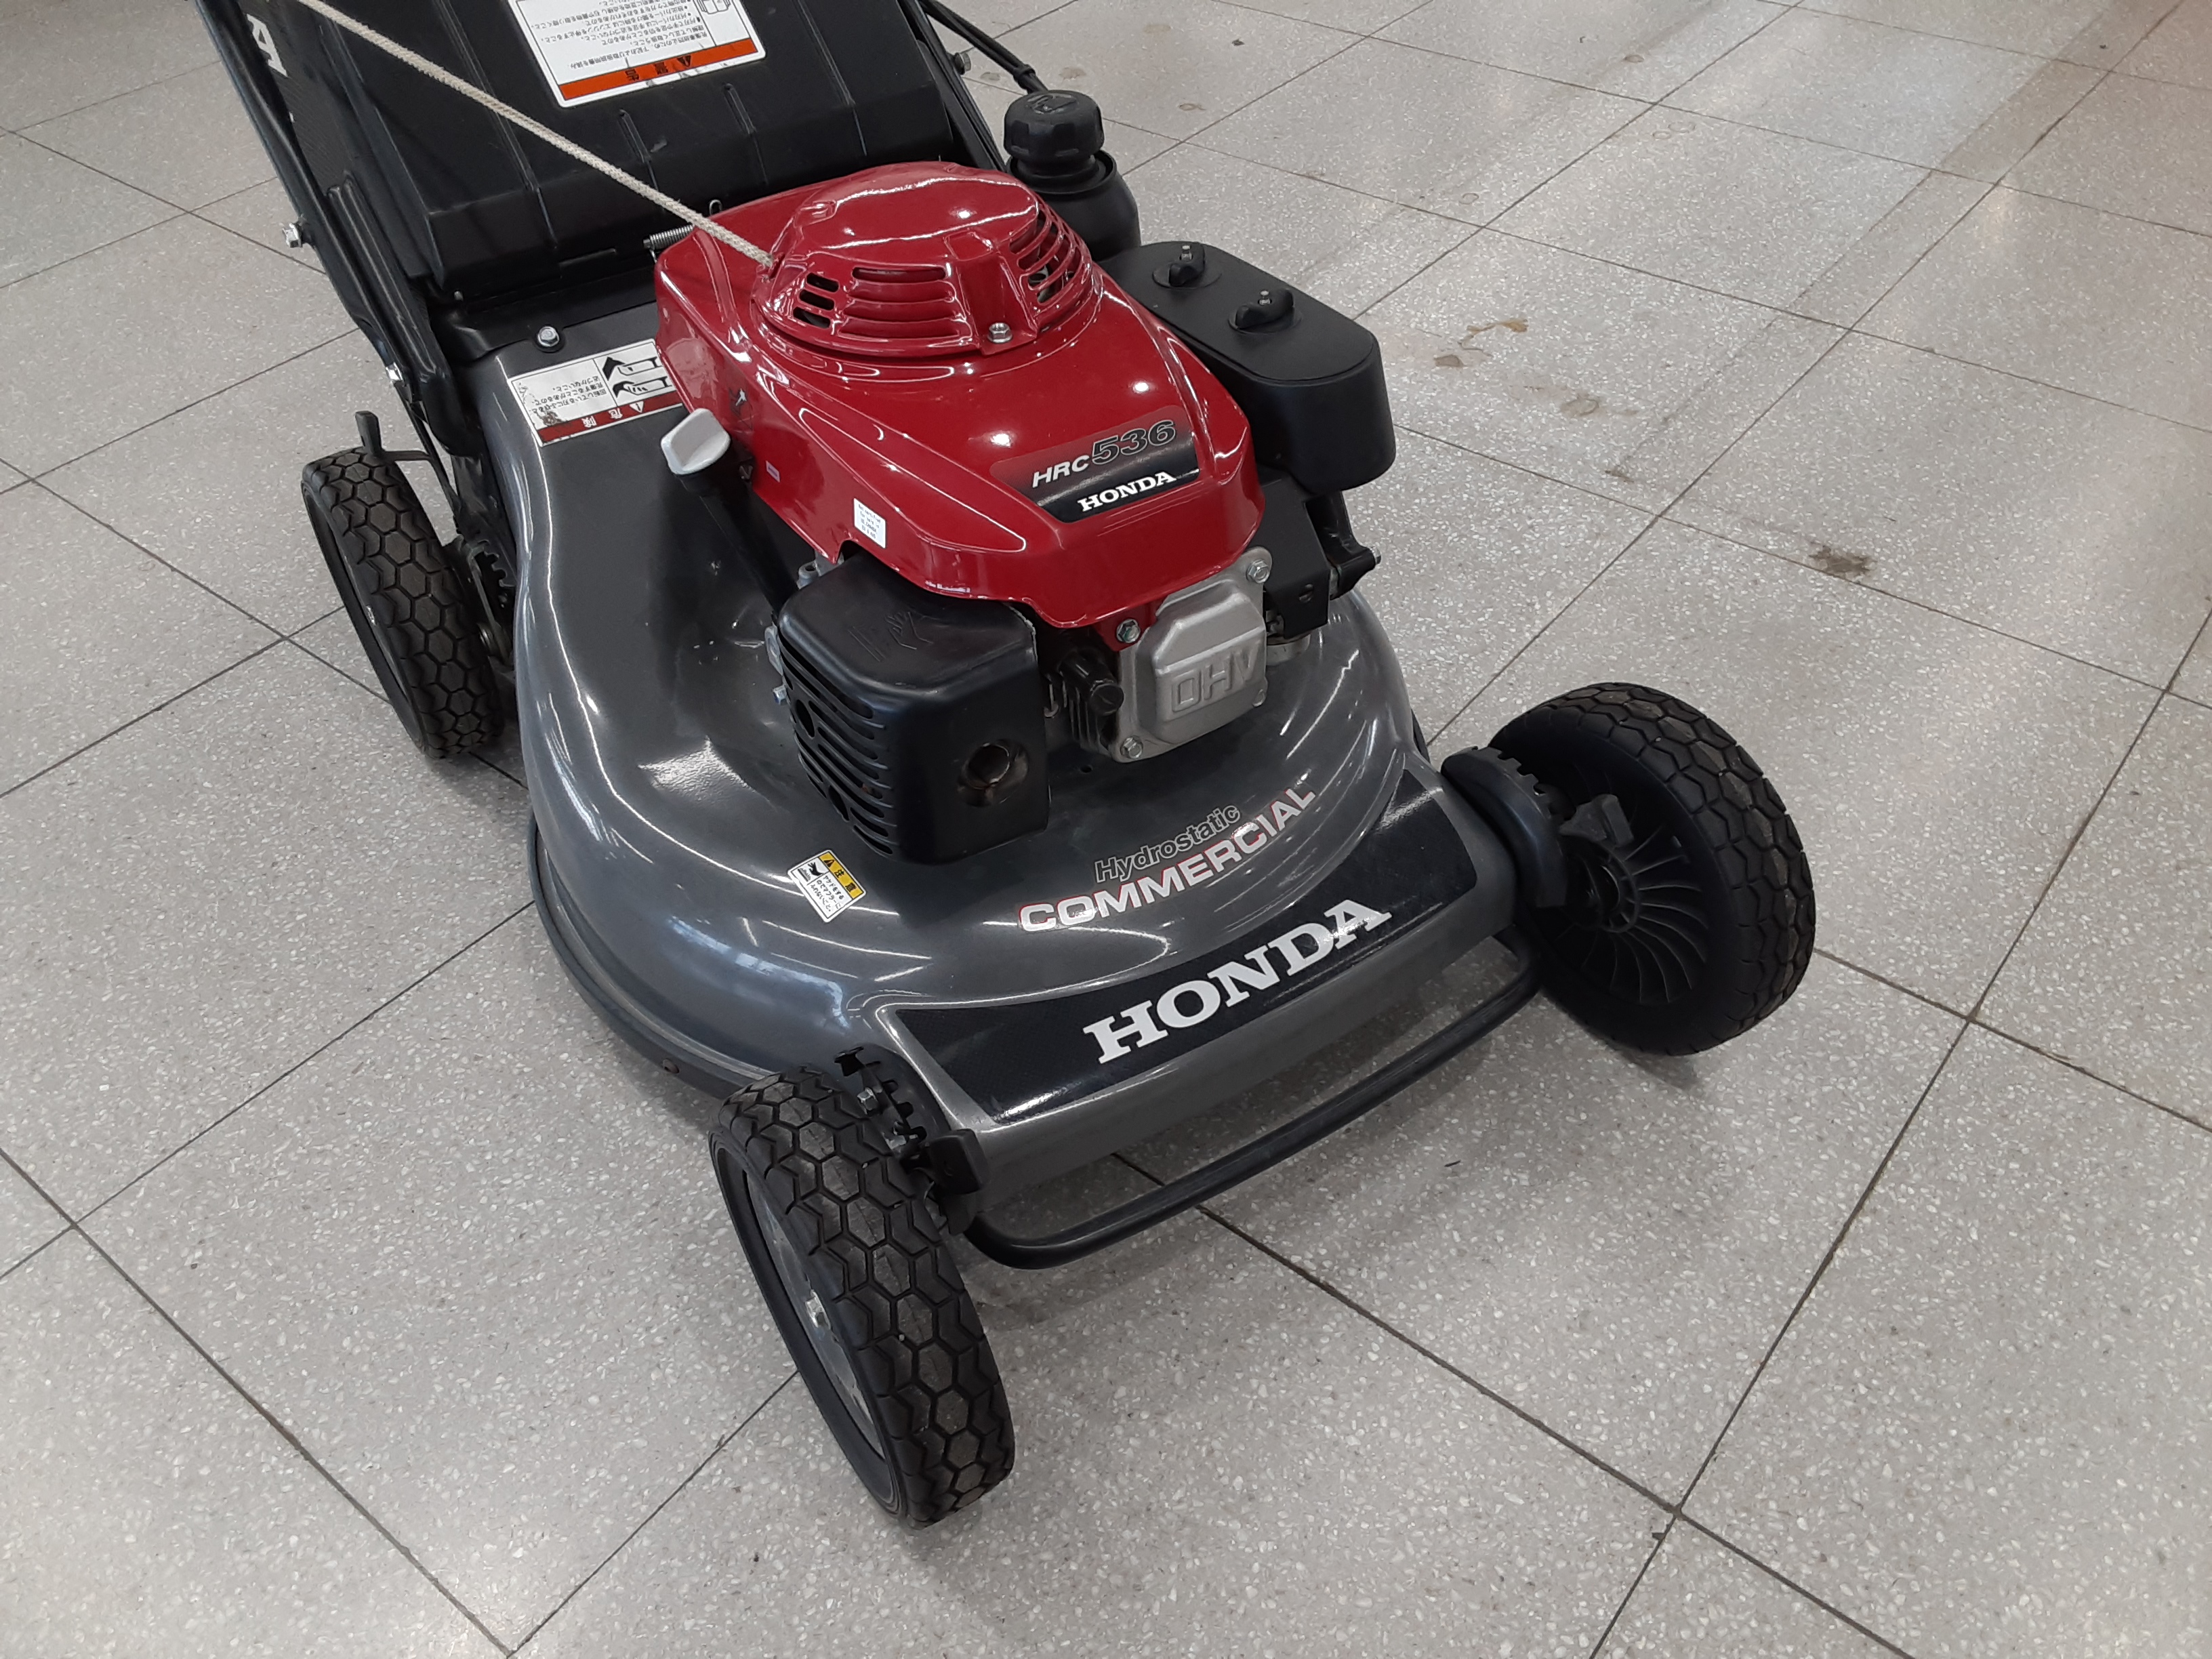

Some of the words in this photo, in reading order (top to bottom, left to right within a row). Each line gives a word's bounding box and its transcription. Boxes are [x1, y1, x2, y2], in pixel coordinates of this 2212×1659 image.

[581, 407, 623, 428] 危険
[1077, 471, 1177, 512] HONDA
[1171, 640, 1261, 713] OHV
[1019, 786, 1316, 933] COMMERCIAL
[1094, 803, 1242, 884] Hydrostatic
[1082, 898, 1393, 1065] HONDA
